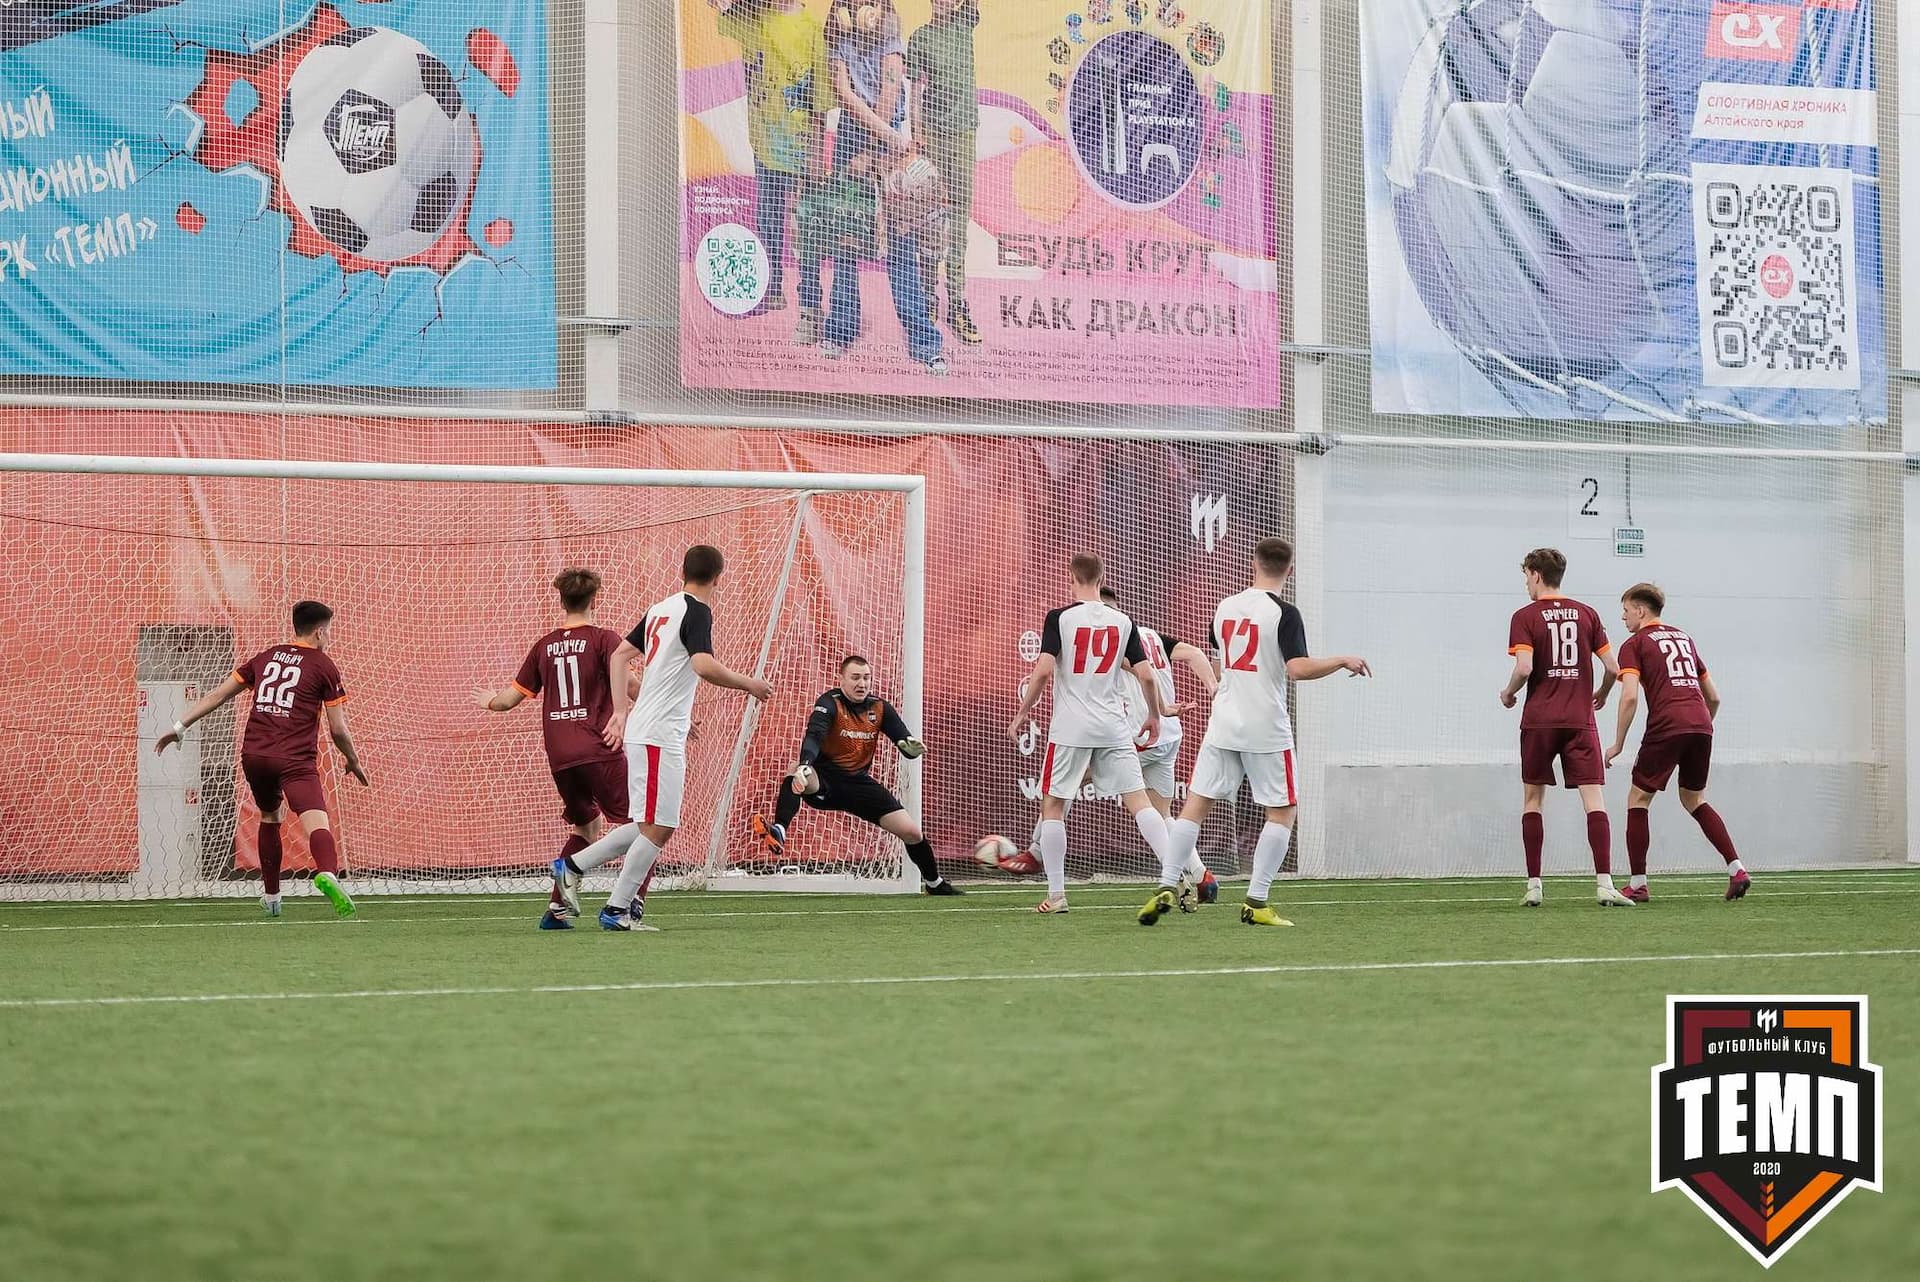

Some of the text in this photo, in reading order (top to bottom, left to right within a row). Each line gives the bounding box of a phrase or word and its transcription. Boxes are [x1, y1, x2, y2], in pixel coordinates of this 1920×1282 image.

[1128, 99, 1152, 109] ПРИЗ
[1704, 114, 1804, 132] Алтайского края
[1707, 96, 1847, 113] СПОРТИВНАЯ ХРОНИКА
[44, 213, 158, 268] «ТЕМП»
[997, 233, 1115, 277] БУДЬ
[999, 294, 1248, 340] КАК ДРАКОН!
[1581, 478, 1599, 515] 2
[1072, 625, 1120, 674] 19
[1221, 618, 1259, 673] 12
[1547, 621, 1579, 667] 18
[1658, 638, 1698, 678] 25
[256, 661, 302, 709] 22
[554, 655, 581, 708] 11
[1547, 668, 1580, 678] SEUS
[256, 704, 291, 718] SEUS
[550, 708, 588, 721] SEUS
